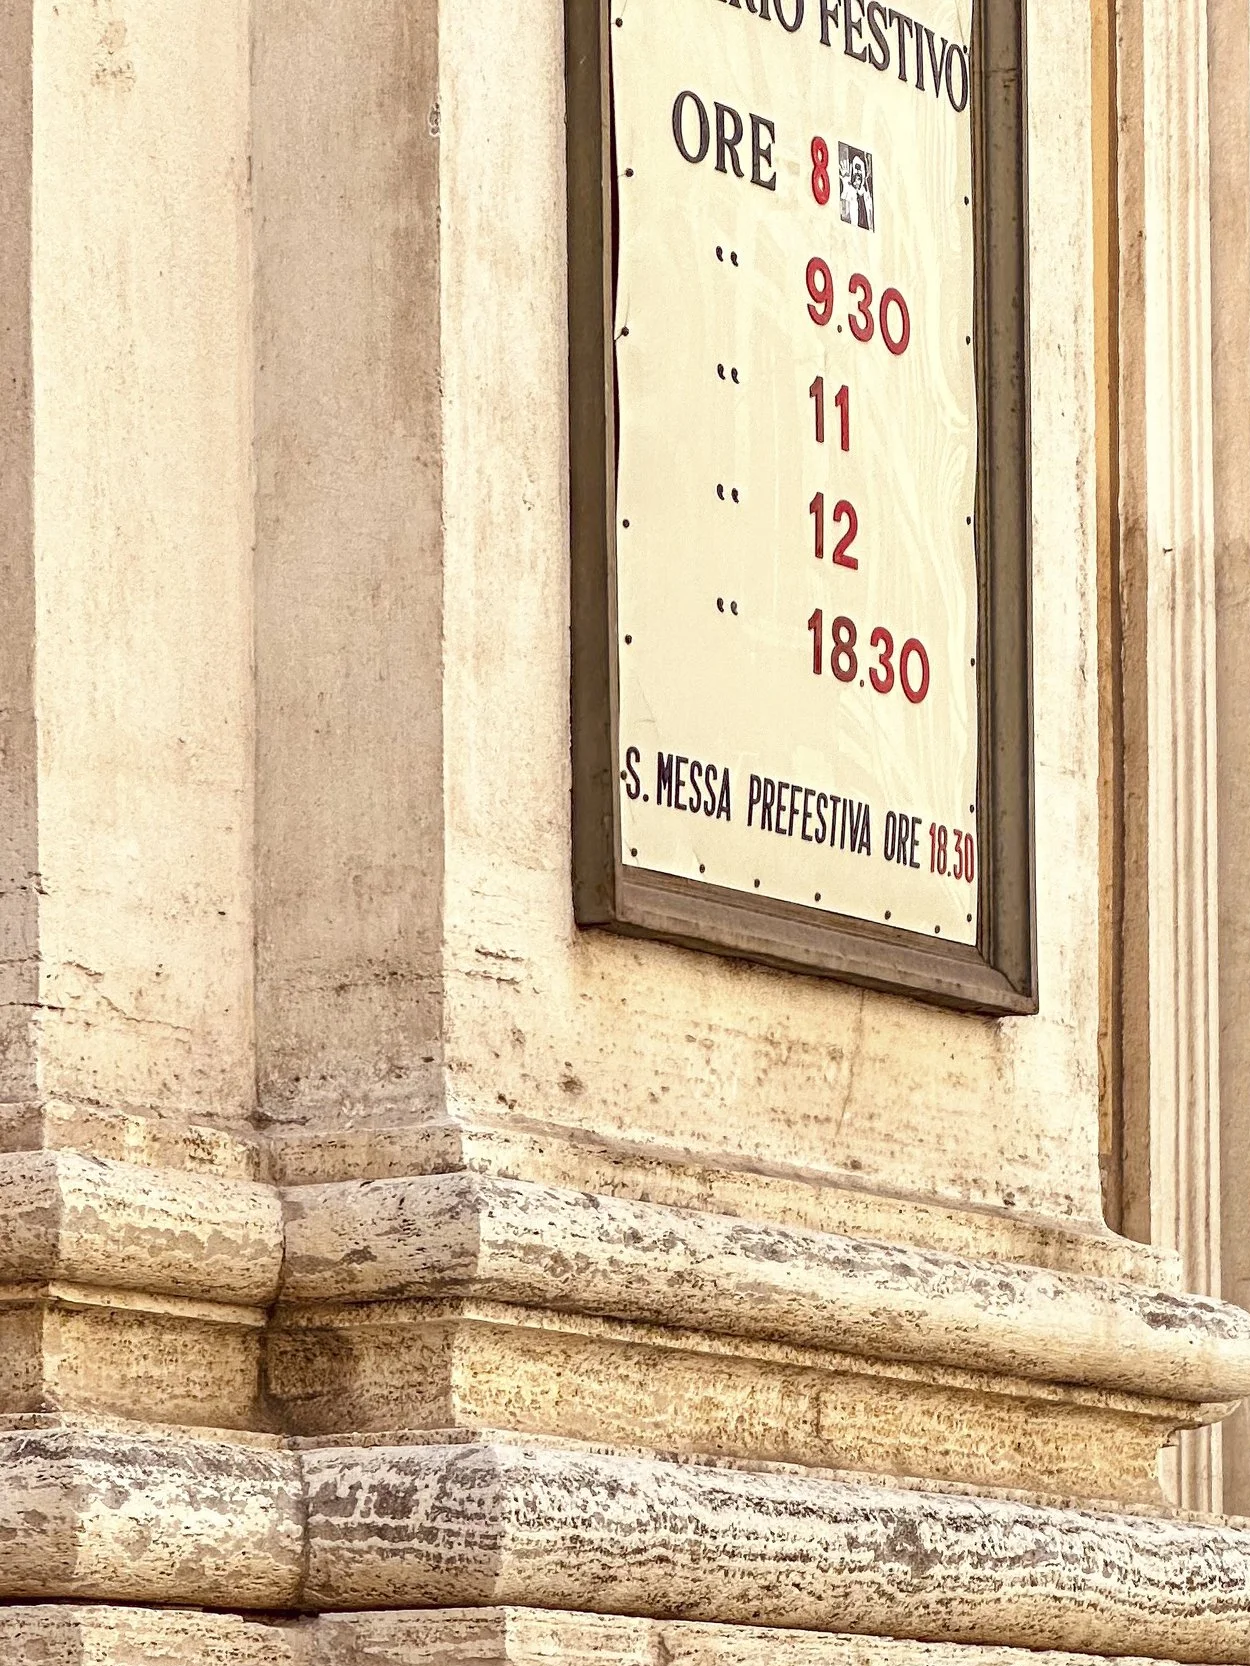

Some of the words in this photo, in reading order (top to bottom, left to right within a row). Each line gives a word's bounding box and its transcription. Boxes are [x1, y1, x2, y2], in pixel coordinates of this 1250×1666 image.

[820, 0, 968, 112] FESTIVO
[672, 91, 776, 191] ORE
[811, 136, 830, 205] 8
[806, 257, 910, 355] 9.30
[809, 376, 849, 451] 11
[809, 492, 858, 570] 12
[808, 608, 929, 703] 18.30
[657, 752, 730, 821] MESSA
[747, 774, 871, 856] PREFESTIVA
[884, 811, 922, 868] ORE
[929, 823, 974, 883] 18.30
